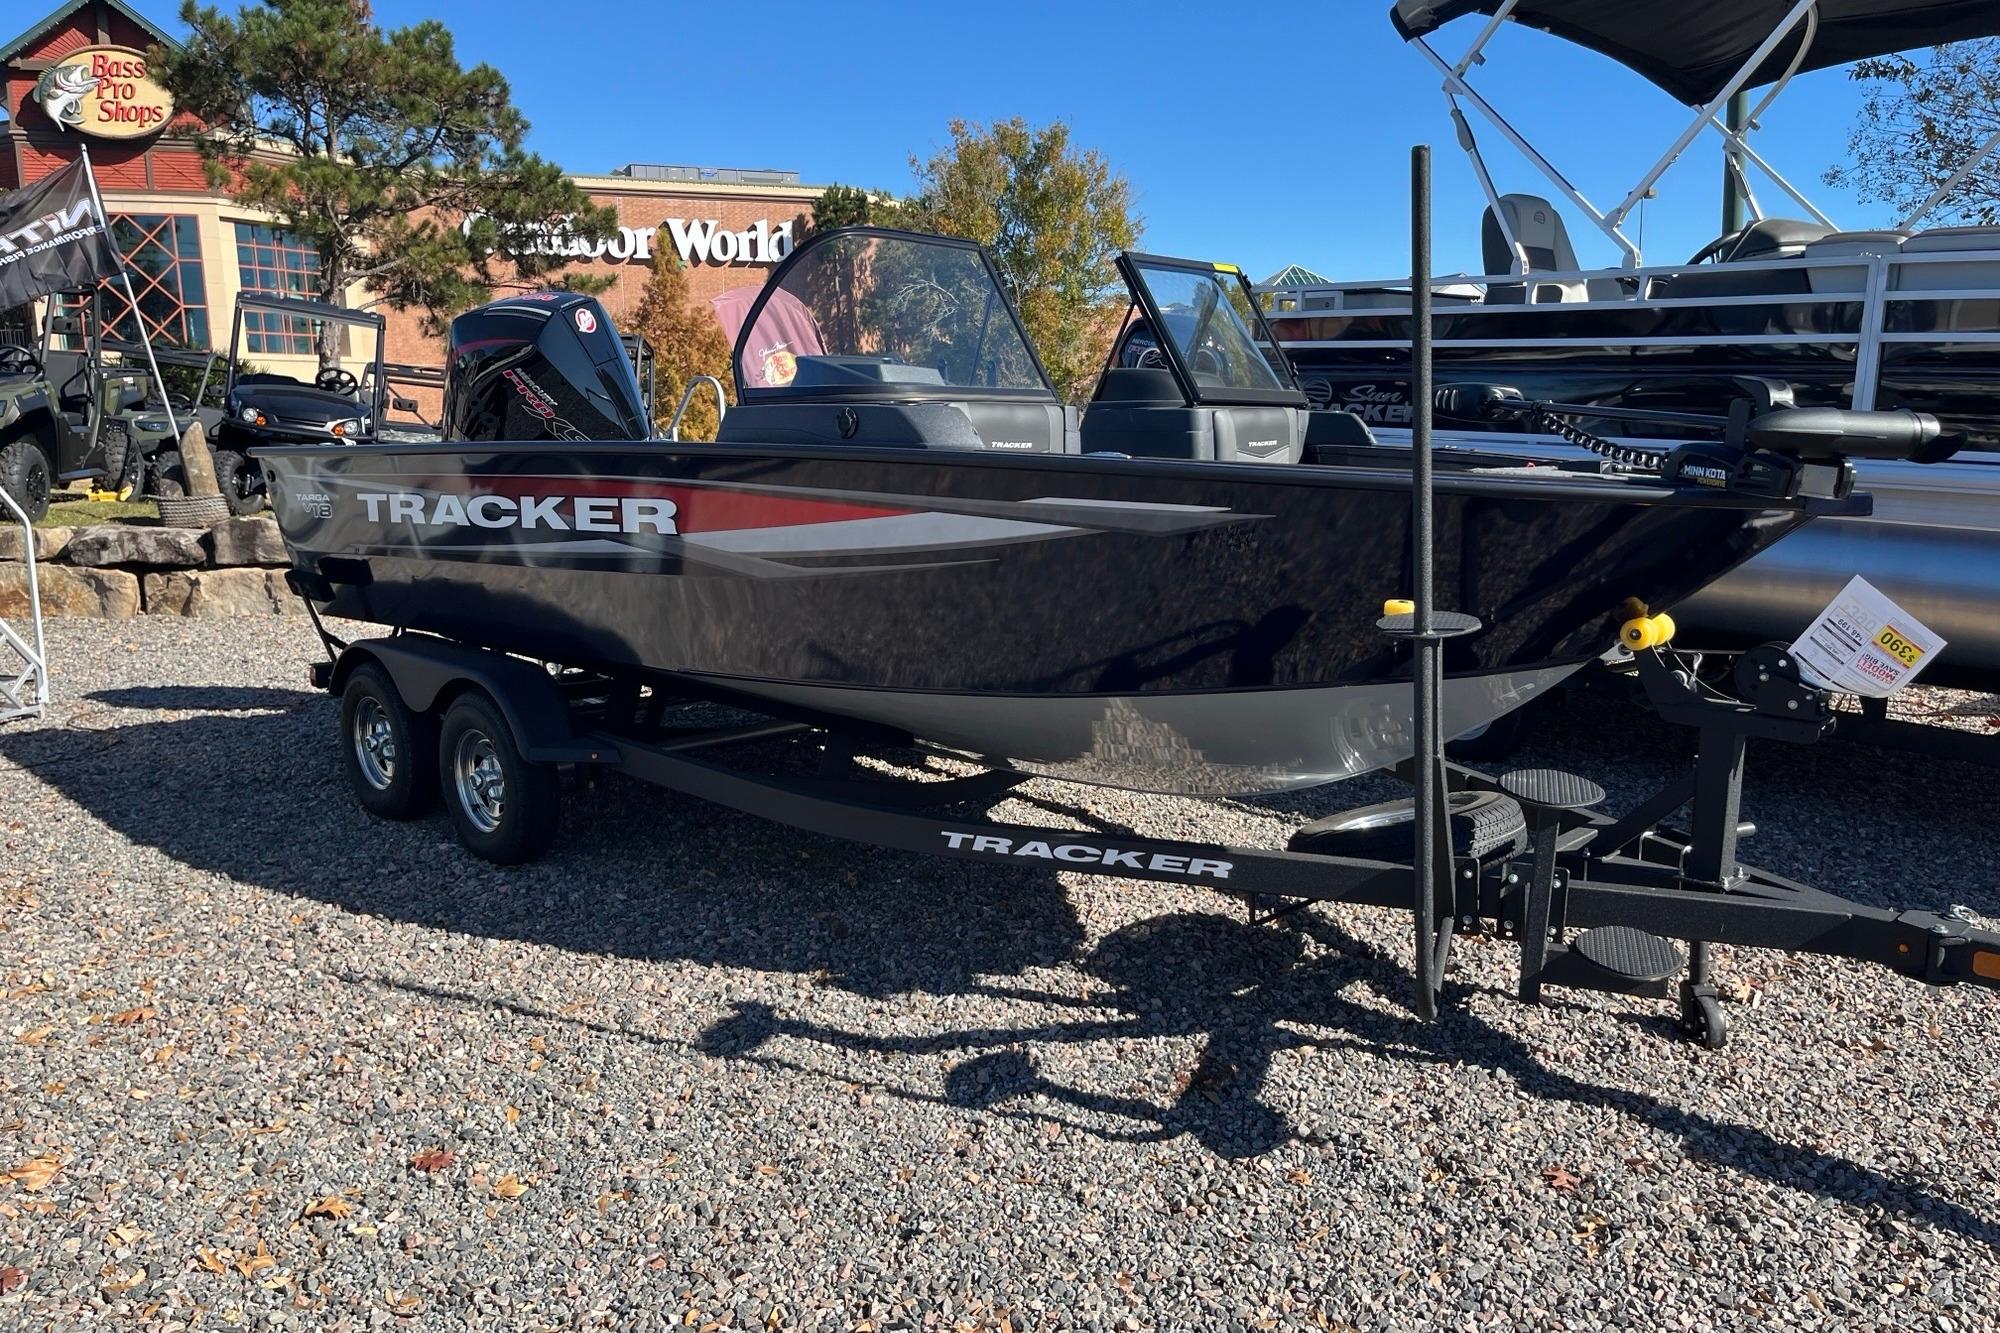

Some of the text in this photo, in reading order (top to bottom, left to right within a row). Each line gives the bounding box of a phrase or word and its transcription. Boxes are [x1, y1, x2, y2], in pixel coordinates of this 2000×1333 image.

[92, 54, 146, 79] Bass
[95, 78, 136, 100] Pro
[98, 100, 165, 128] Shops
[666, 218, 794, 263] World
[514, 367, 558, 406] MERCURY
[1344, 384, 1403, 402] Sun
[991, 441, 1033, 449] TRACKER
[1248, 440, 1278, 448] TRACKER
[1683, 464, 1727, 480] MINN KOTA
[295, 493, 330, 502] TARGA
[302, 502, 333, 519] V18
[356, 493, 679, 535] TRACKER
[1880, 632, 1915, 663] $390
[941, 831, 1234, 879] TRACKER
